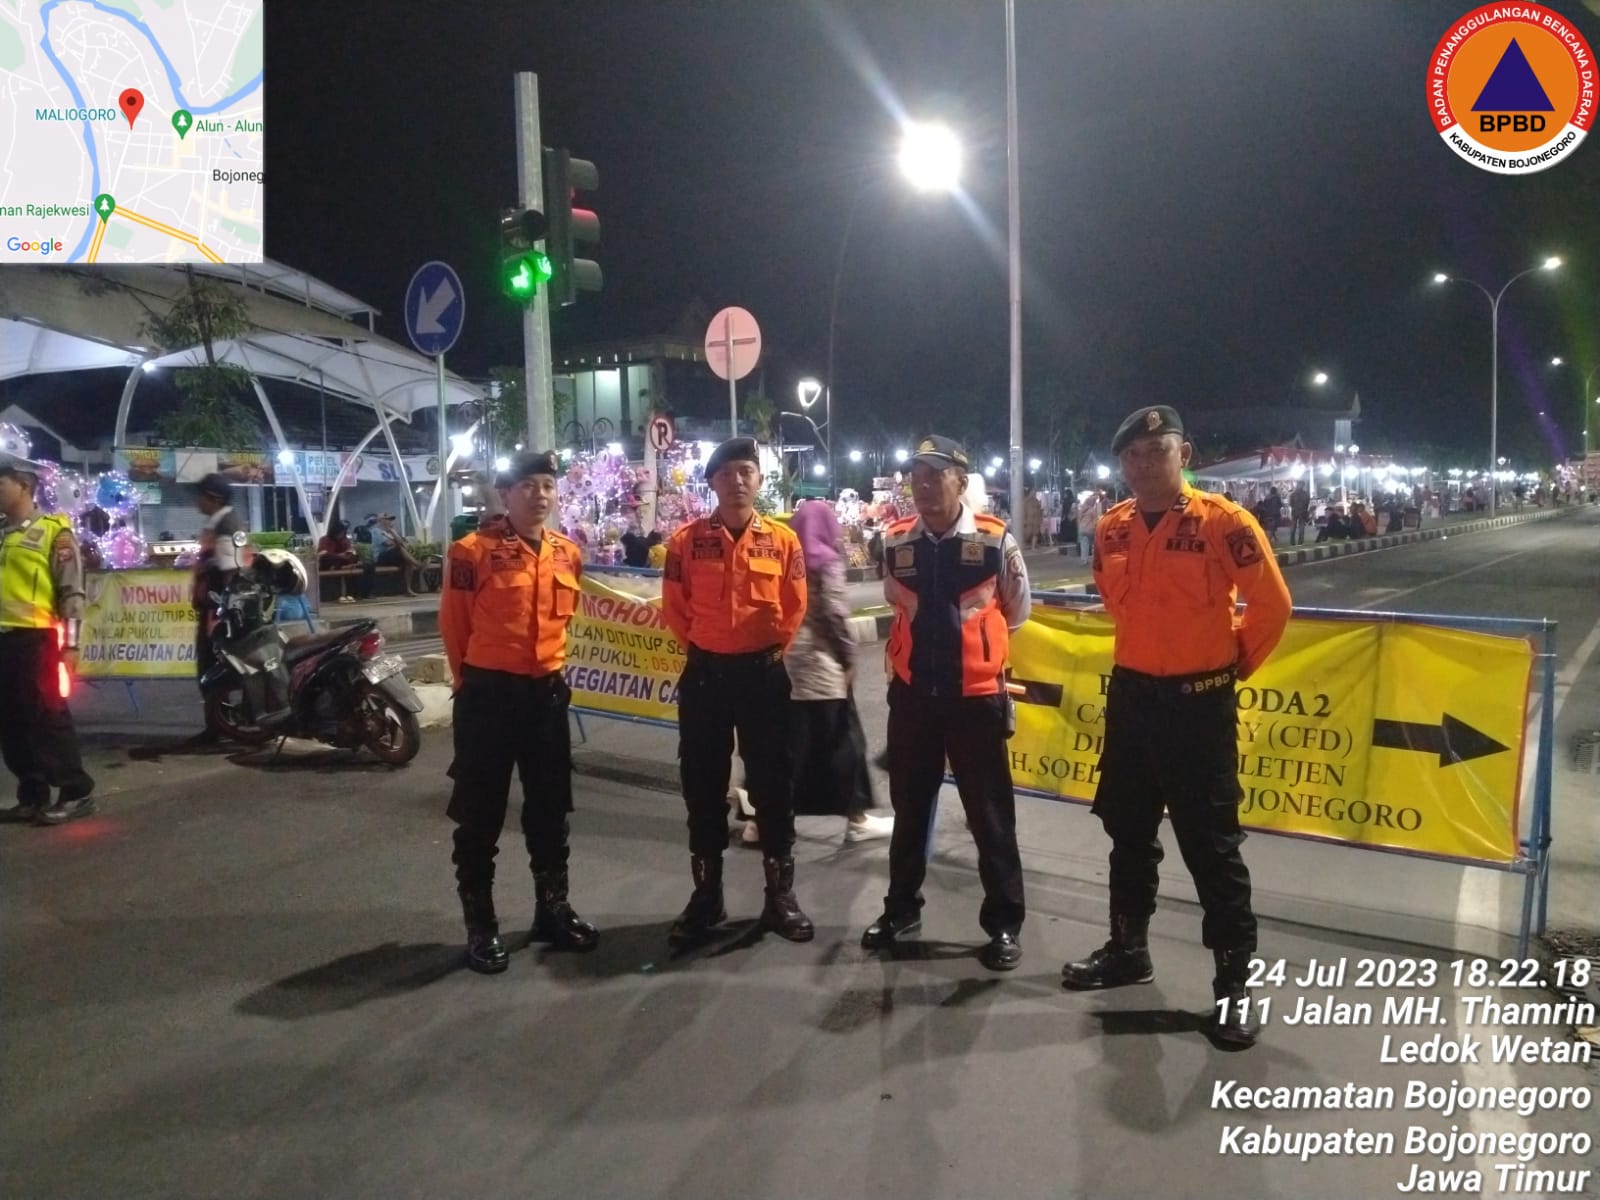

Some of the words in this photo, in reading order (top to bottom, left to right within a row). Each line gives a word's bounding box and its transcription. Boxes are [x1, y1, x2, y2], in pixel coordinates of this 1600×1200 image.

[121, 585, 181, 604] MOHON
[139, 610, 185, 623] DITUTUP
[566, 624, 603, 643] ALAN
[607, 628, 662, 651] DITUTUP
[83, 644, 105, 660] ADA
[108, 644, 174, 661] KEGIATAN
[590, 646, 641, 669] PUKUL
[564, 665, 655, 700] KEGIATAN
[658, 679, 681, 705] CA
[1195, 673, 1230, 692] BPBD
[1236, 687, 1309, 717] ODA
[1077, 703, 1107, 724] CA
[1268, 720, 1353, 759] (CFD)
[1240, 753, 1347, 787] LETJEN
[1242, 787, 1422, 832] JONEGORO
